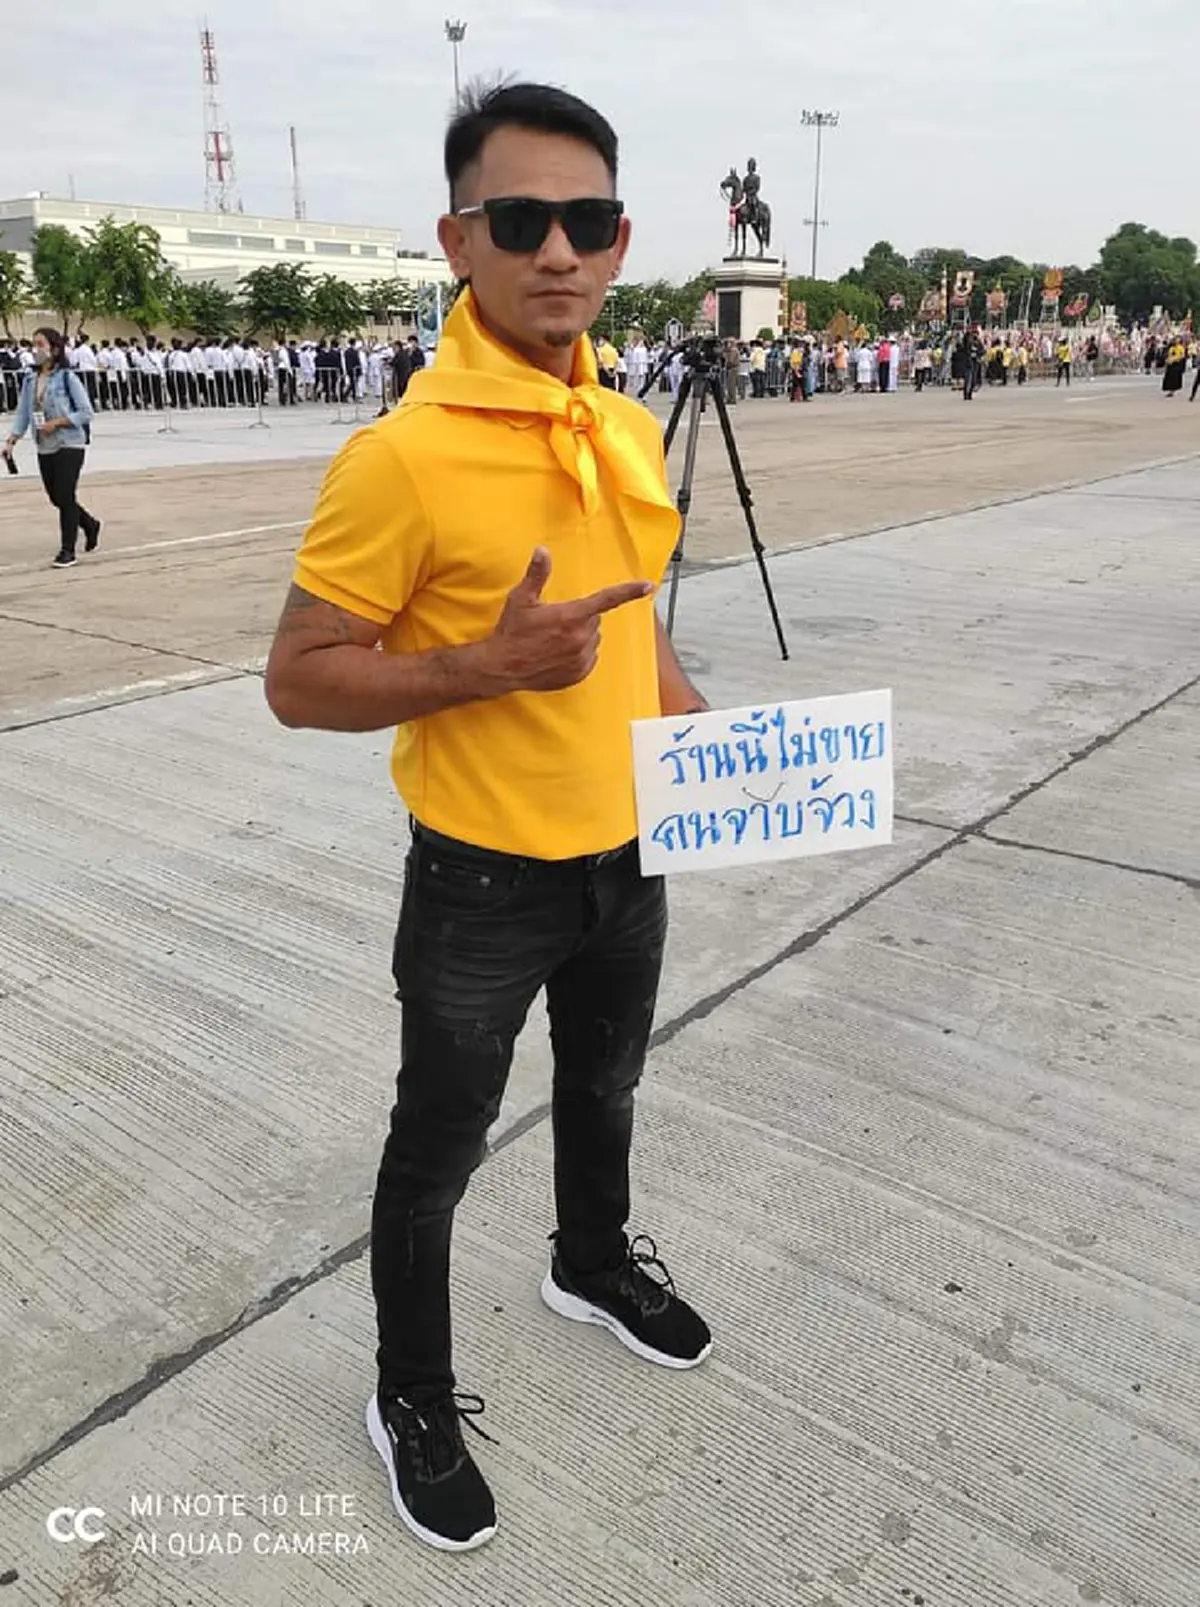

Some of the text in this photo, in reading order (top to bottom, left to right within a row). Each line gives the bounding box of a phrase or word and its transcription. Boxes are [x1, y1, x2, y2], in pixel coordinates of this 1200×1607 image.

[659, 706, 885, 786] ร้านนี้ไม่ขาย
